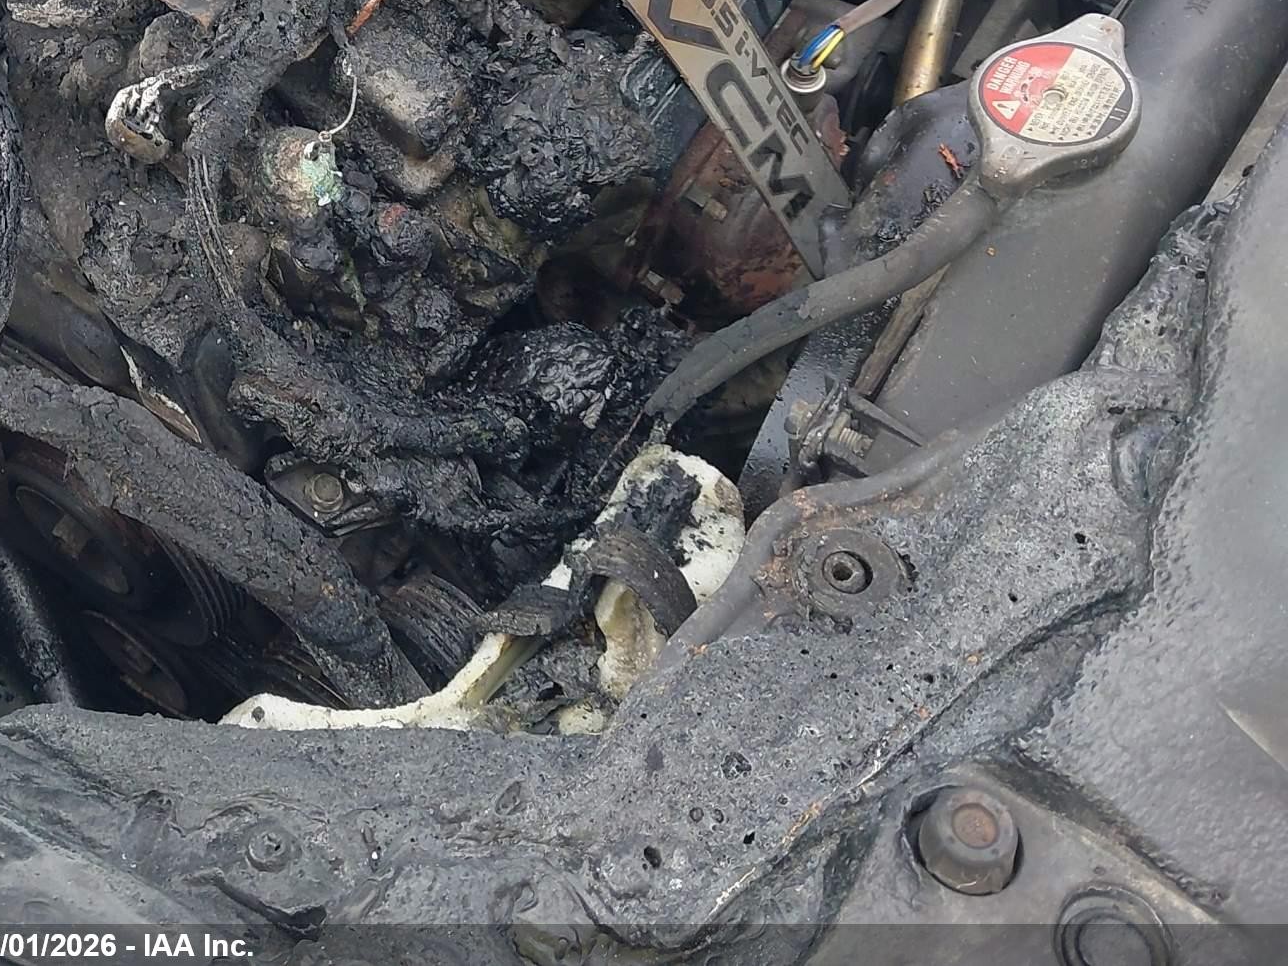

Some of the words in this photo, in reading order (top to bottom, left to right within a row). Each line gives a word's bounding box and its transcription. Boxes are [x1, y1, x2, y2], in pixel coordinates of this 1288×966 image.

[986, 56, 1018, 91] DANGER
[999, 60, 1032, 95] WARNING
[735, 30, 811, 156] i-VTEC
